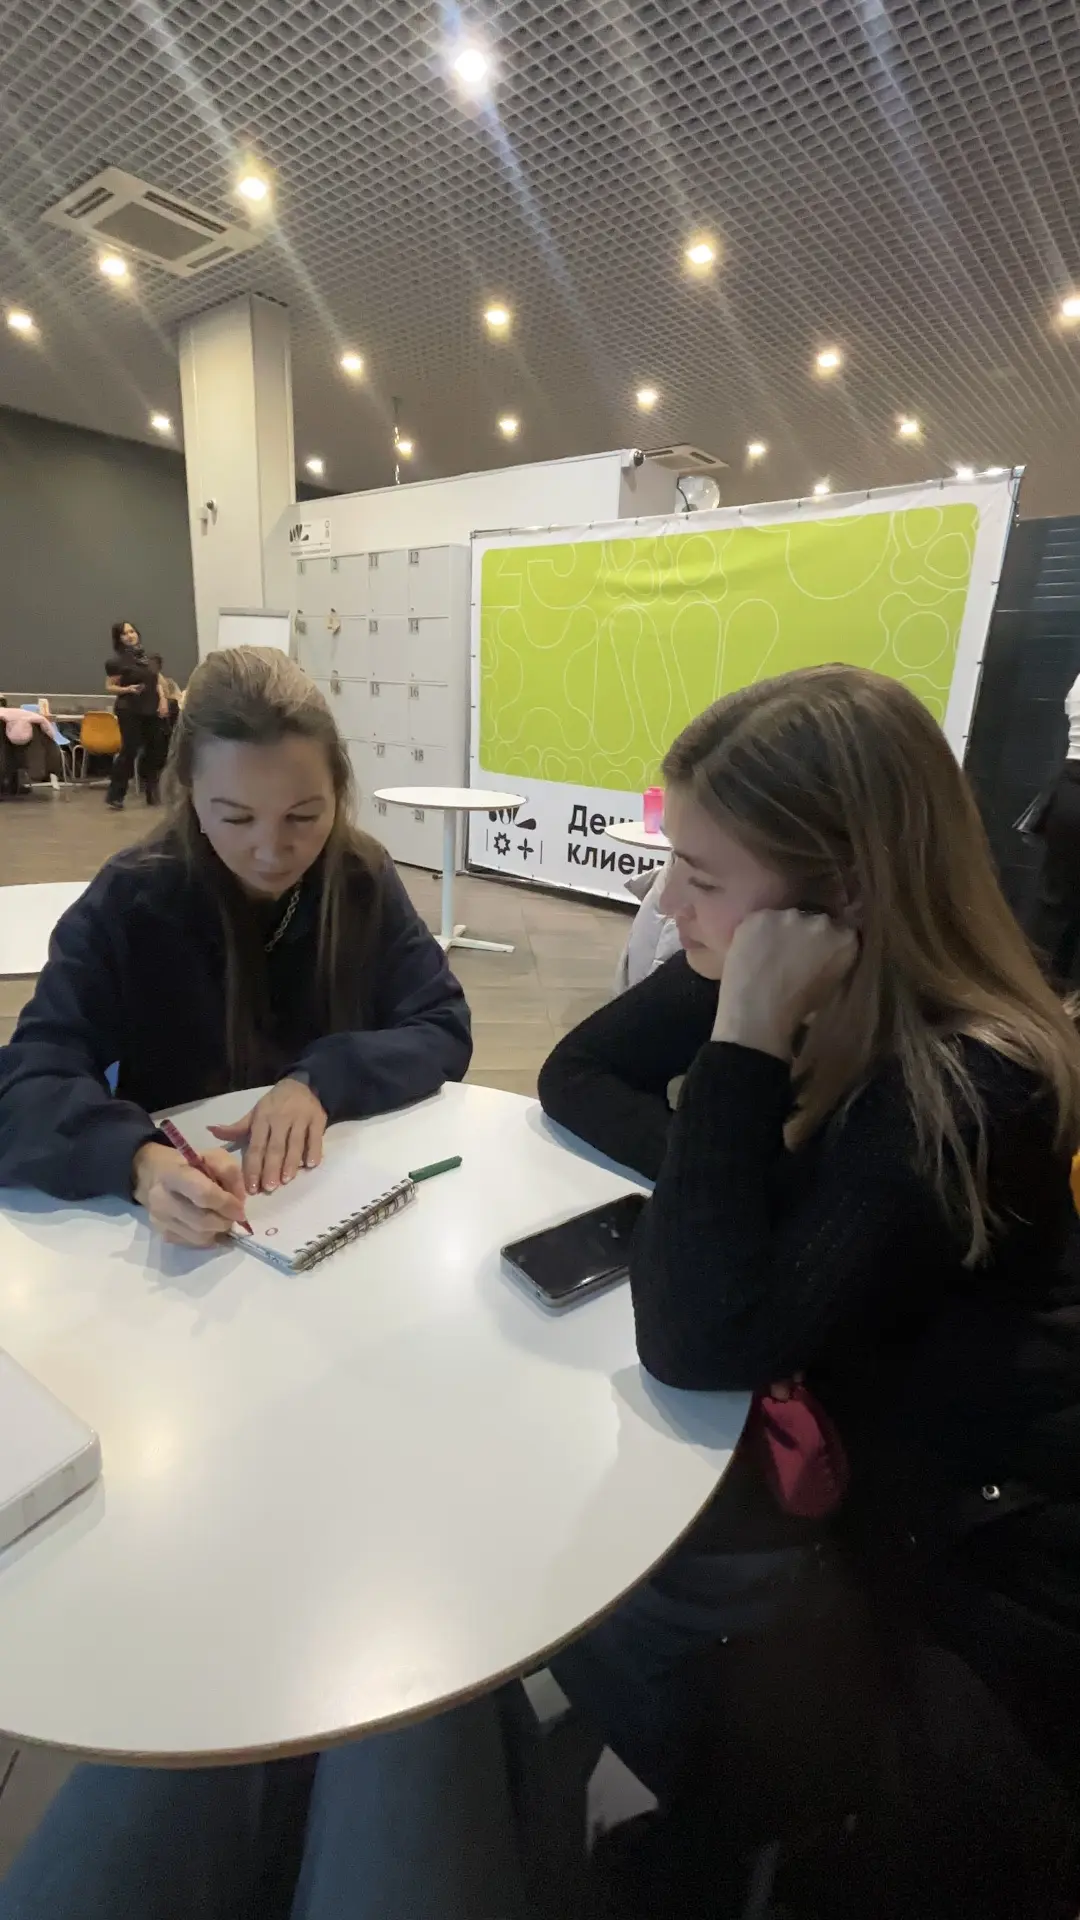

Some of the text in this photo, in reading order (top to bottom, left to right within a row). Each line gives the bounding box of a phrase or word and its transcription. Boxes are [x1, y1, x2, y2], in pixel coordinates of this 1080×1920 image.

[410, 551, 419, 564] 12
[410, 619, 419, 632] 14
[371, 683, 380, 696] 15
[410, 686, 419, 698] 16
[377, 744, 385, 755] 17
[414, 749, 424, 761] 18
[568, 804, 634, 837] Де
[567, 843, 665, 875] клиен
